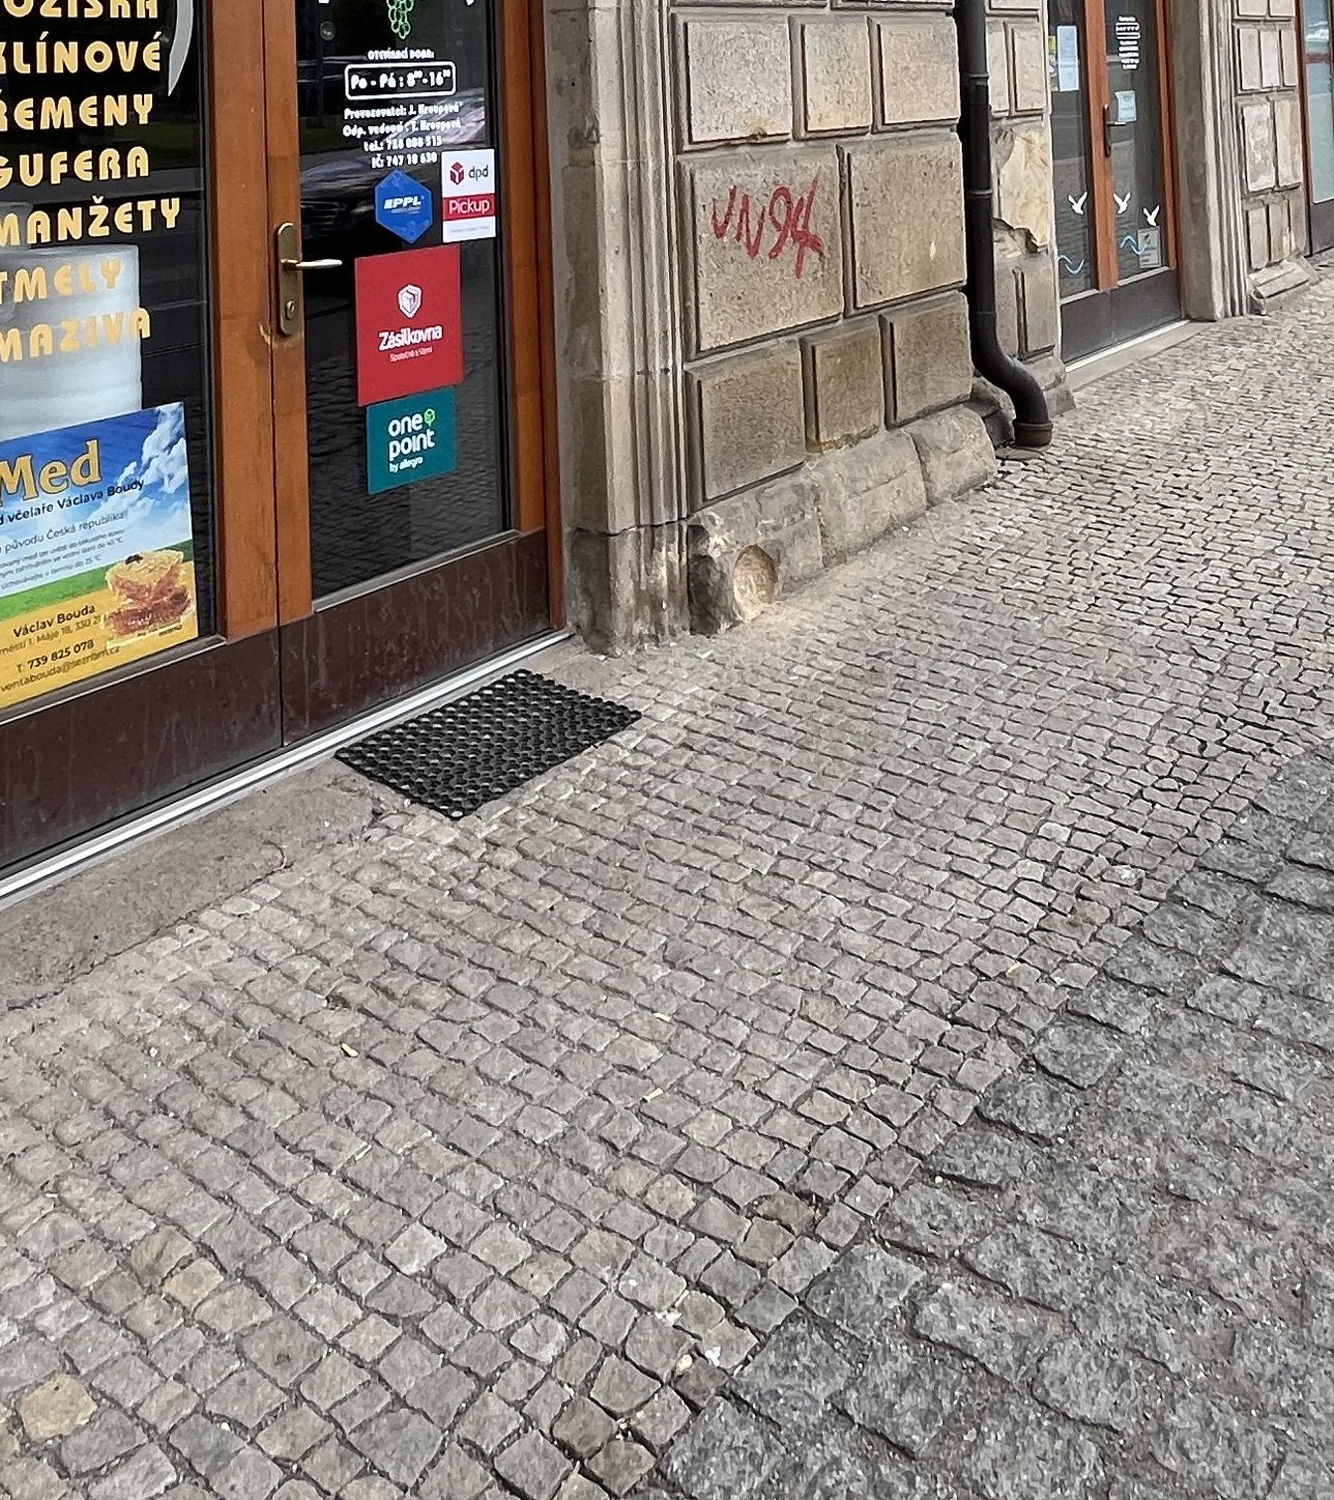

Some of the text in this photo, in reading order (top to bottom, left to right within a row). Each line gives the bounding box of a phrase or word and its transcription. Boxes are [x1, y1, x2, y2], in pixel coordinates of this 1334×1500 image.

[350, 74, 368, 90] Po
[379, 72, 397, 88] Pá
[343, 124, 366, 138] Odp.
[468, 164, 489, 181] dpd
[449, 198, 490, 214] Pickup
[378, 325, 443, 351] Zásilkovna
[388, 413, 423, 437] one
[388, 428, 435, 462] point
[7, 502, 54, 523] včelaře
[57, 491, 104, 509] Václava
[107, 479, 145, 497] Boudy
[5, 536, 44, 555] původu
[46, 524, 76, 540] Česká
[13, 618, 55, 638] Václav
[56, 604, 96, 625] Bouda
[27, 653, 49, 671] 739
[50, 647, 72, 663] 825
